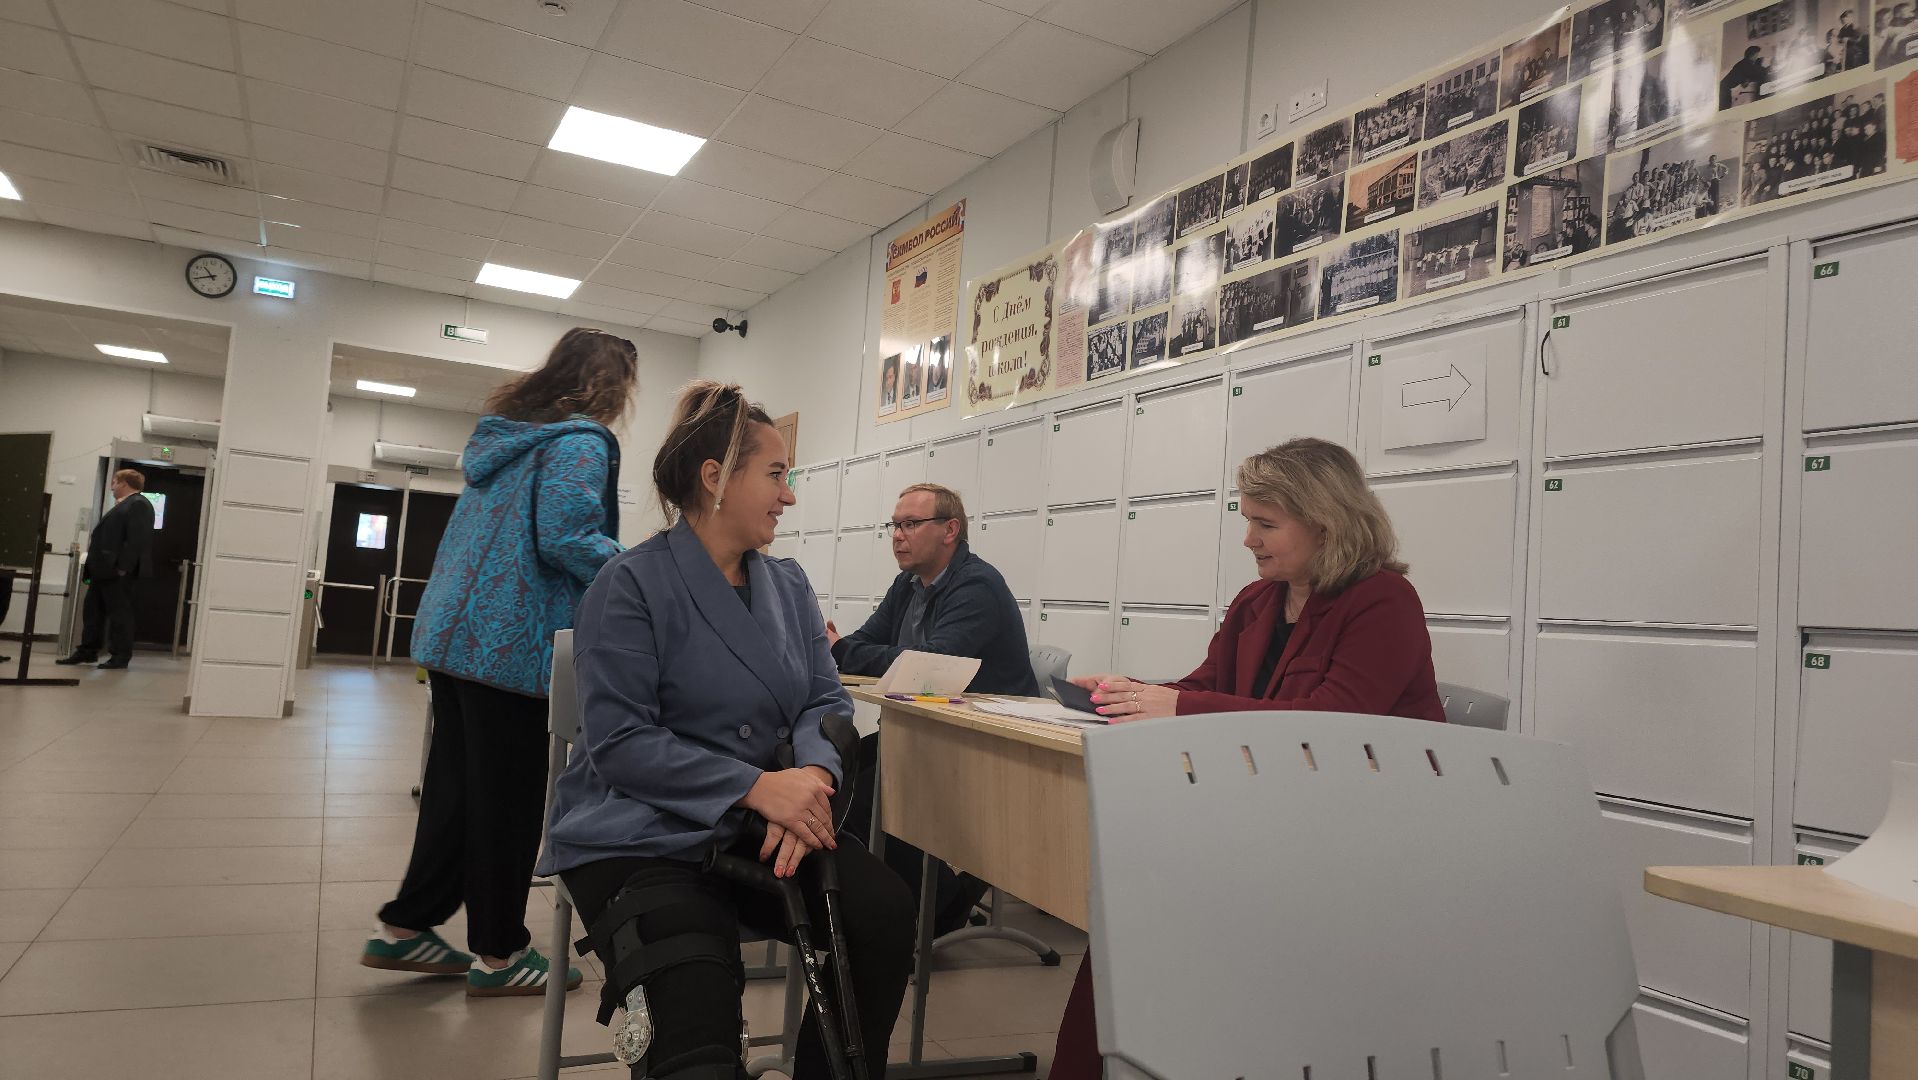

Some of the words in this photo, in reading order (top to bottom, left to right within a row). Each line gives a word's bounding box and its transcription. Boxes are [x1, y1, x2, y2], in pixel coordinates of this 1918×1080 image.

[1820, 265, 1834, 276] 66
[993, 304, 1000, 323] С
[1002, 295, 1032, 323] Днём
[1557, 317, 1566, 327] 61
[1811, 458, 1825, 469] 67
[1549, 480, 1559, 489] 62
[1811, 655, 1825, 667] 68
